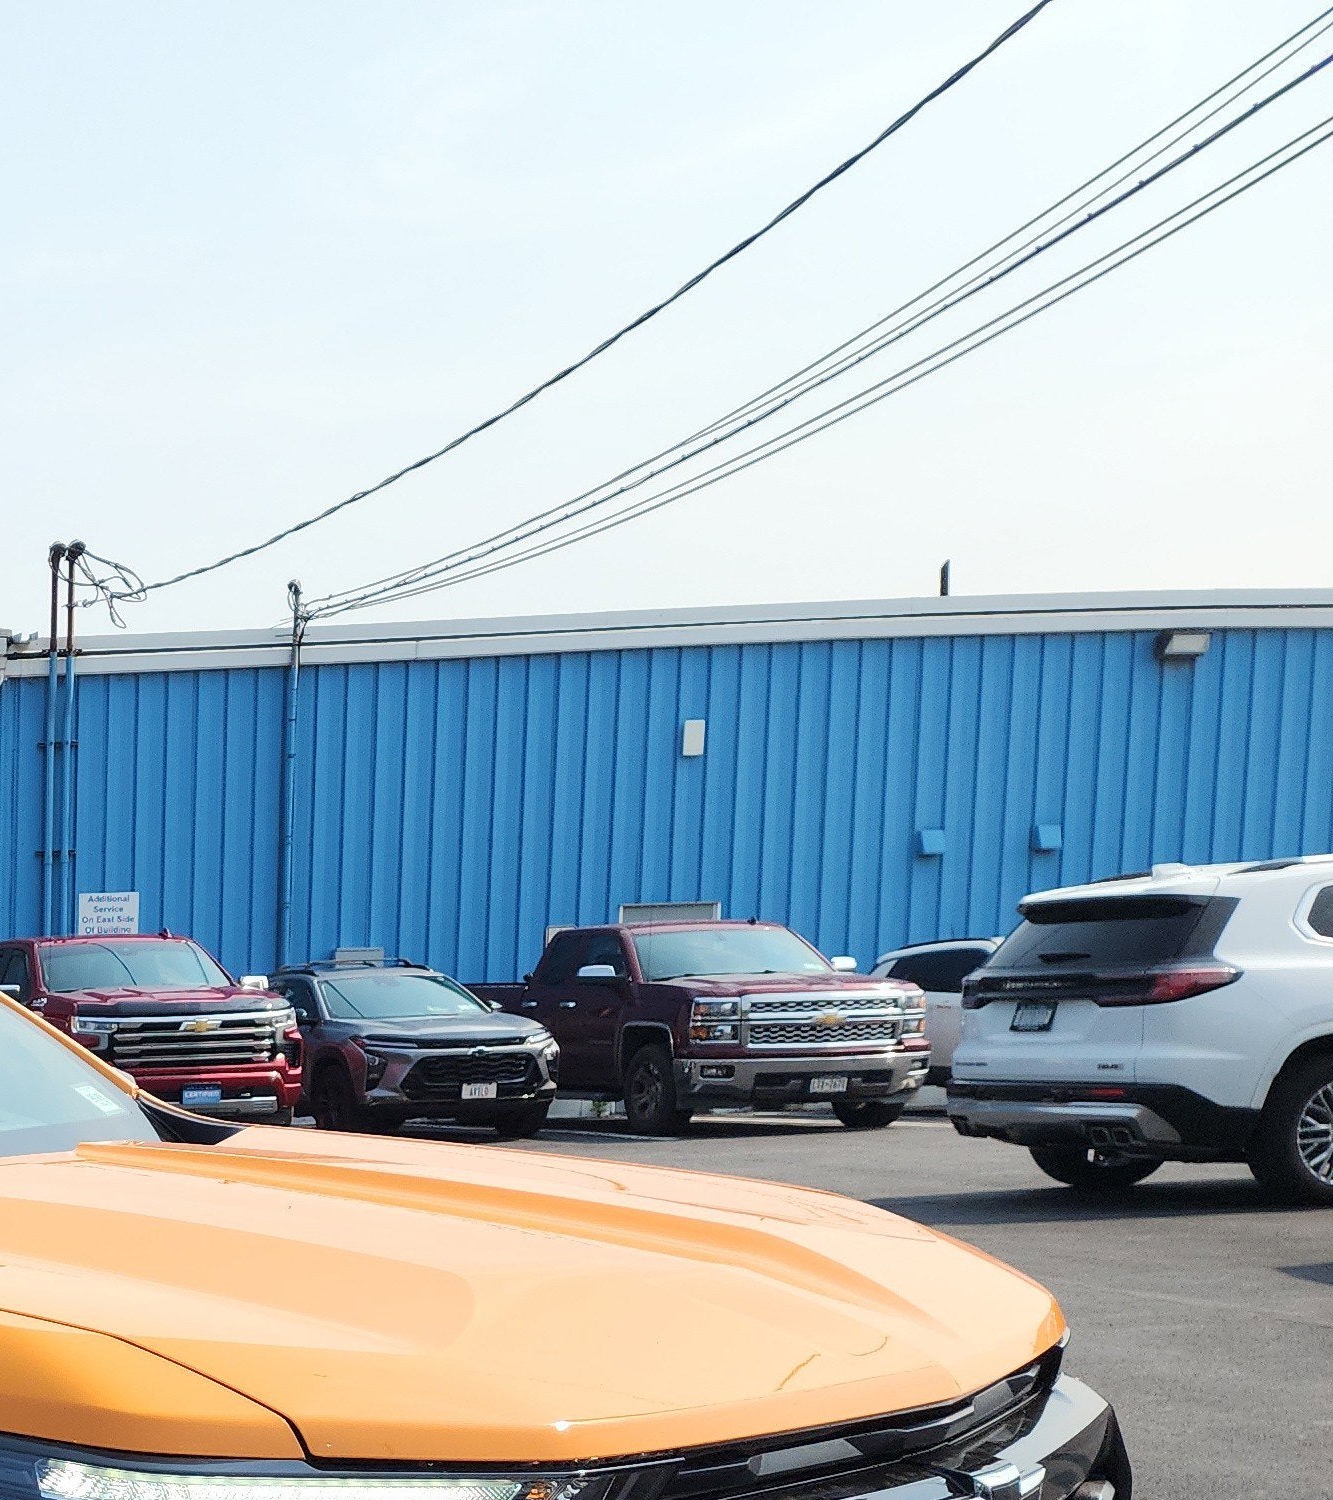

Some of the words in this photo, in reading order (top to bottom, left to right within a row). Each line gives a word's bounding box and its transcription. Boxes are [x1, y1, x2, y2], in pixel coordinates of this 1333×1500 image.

[87, 894, 131, 903] Additional
[93, 905, 124, 913] Service
[81, 916, 94, 924] On
[96, 915, 114, 924] East
[116, 915, 135, 923] Side
